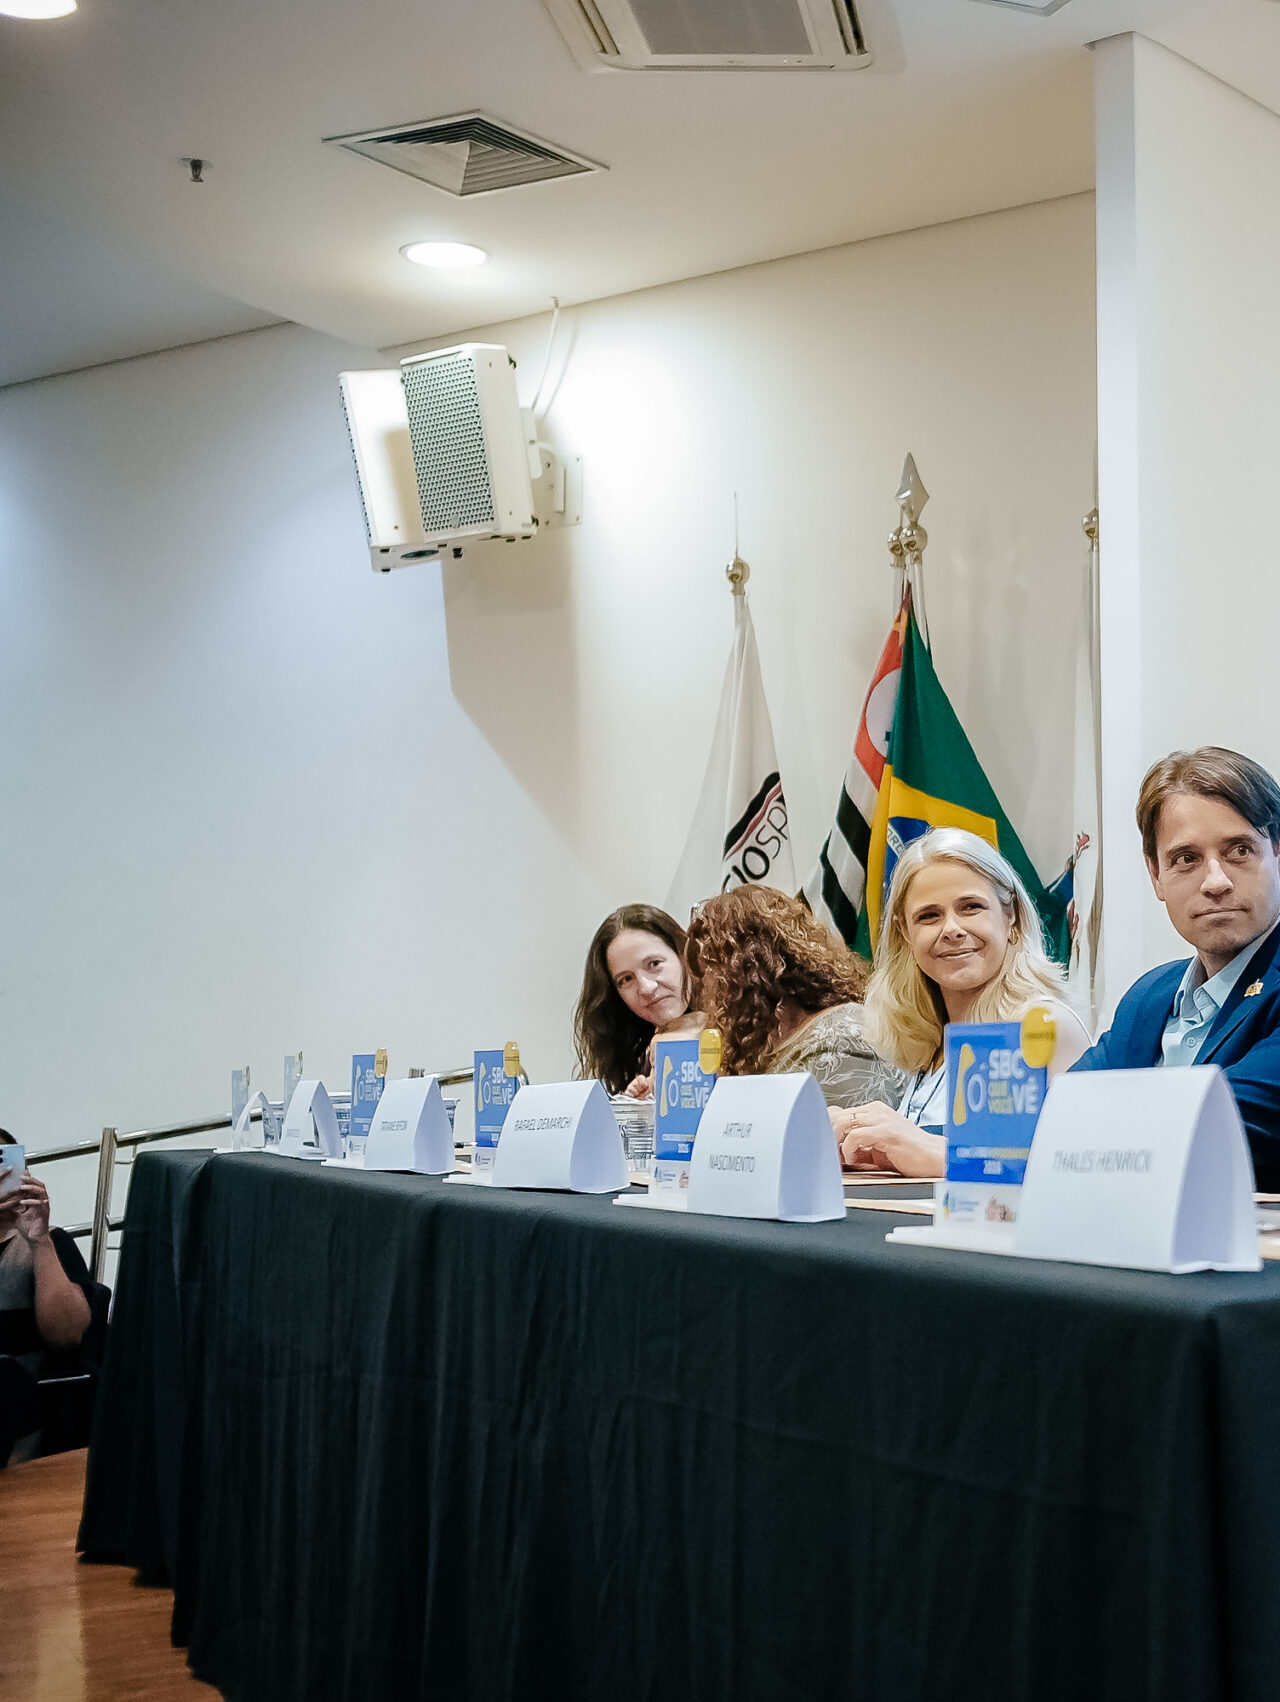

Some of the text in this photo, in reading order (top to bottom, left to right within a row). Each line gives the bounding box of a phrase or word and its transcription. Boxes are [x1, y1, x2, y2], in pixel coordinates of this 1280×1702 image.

[681, 1060, 703, 1083] SBC
[989, 1048, 1025, 1080] SBC
[722, 1122, 753, 1138] ARTHUR
[708, 1154, 755, 1173] NASCIMENTO
[1053, 1149, 1096, 1174] THALES
